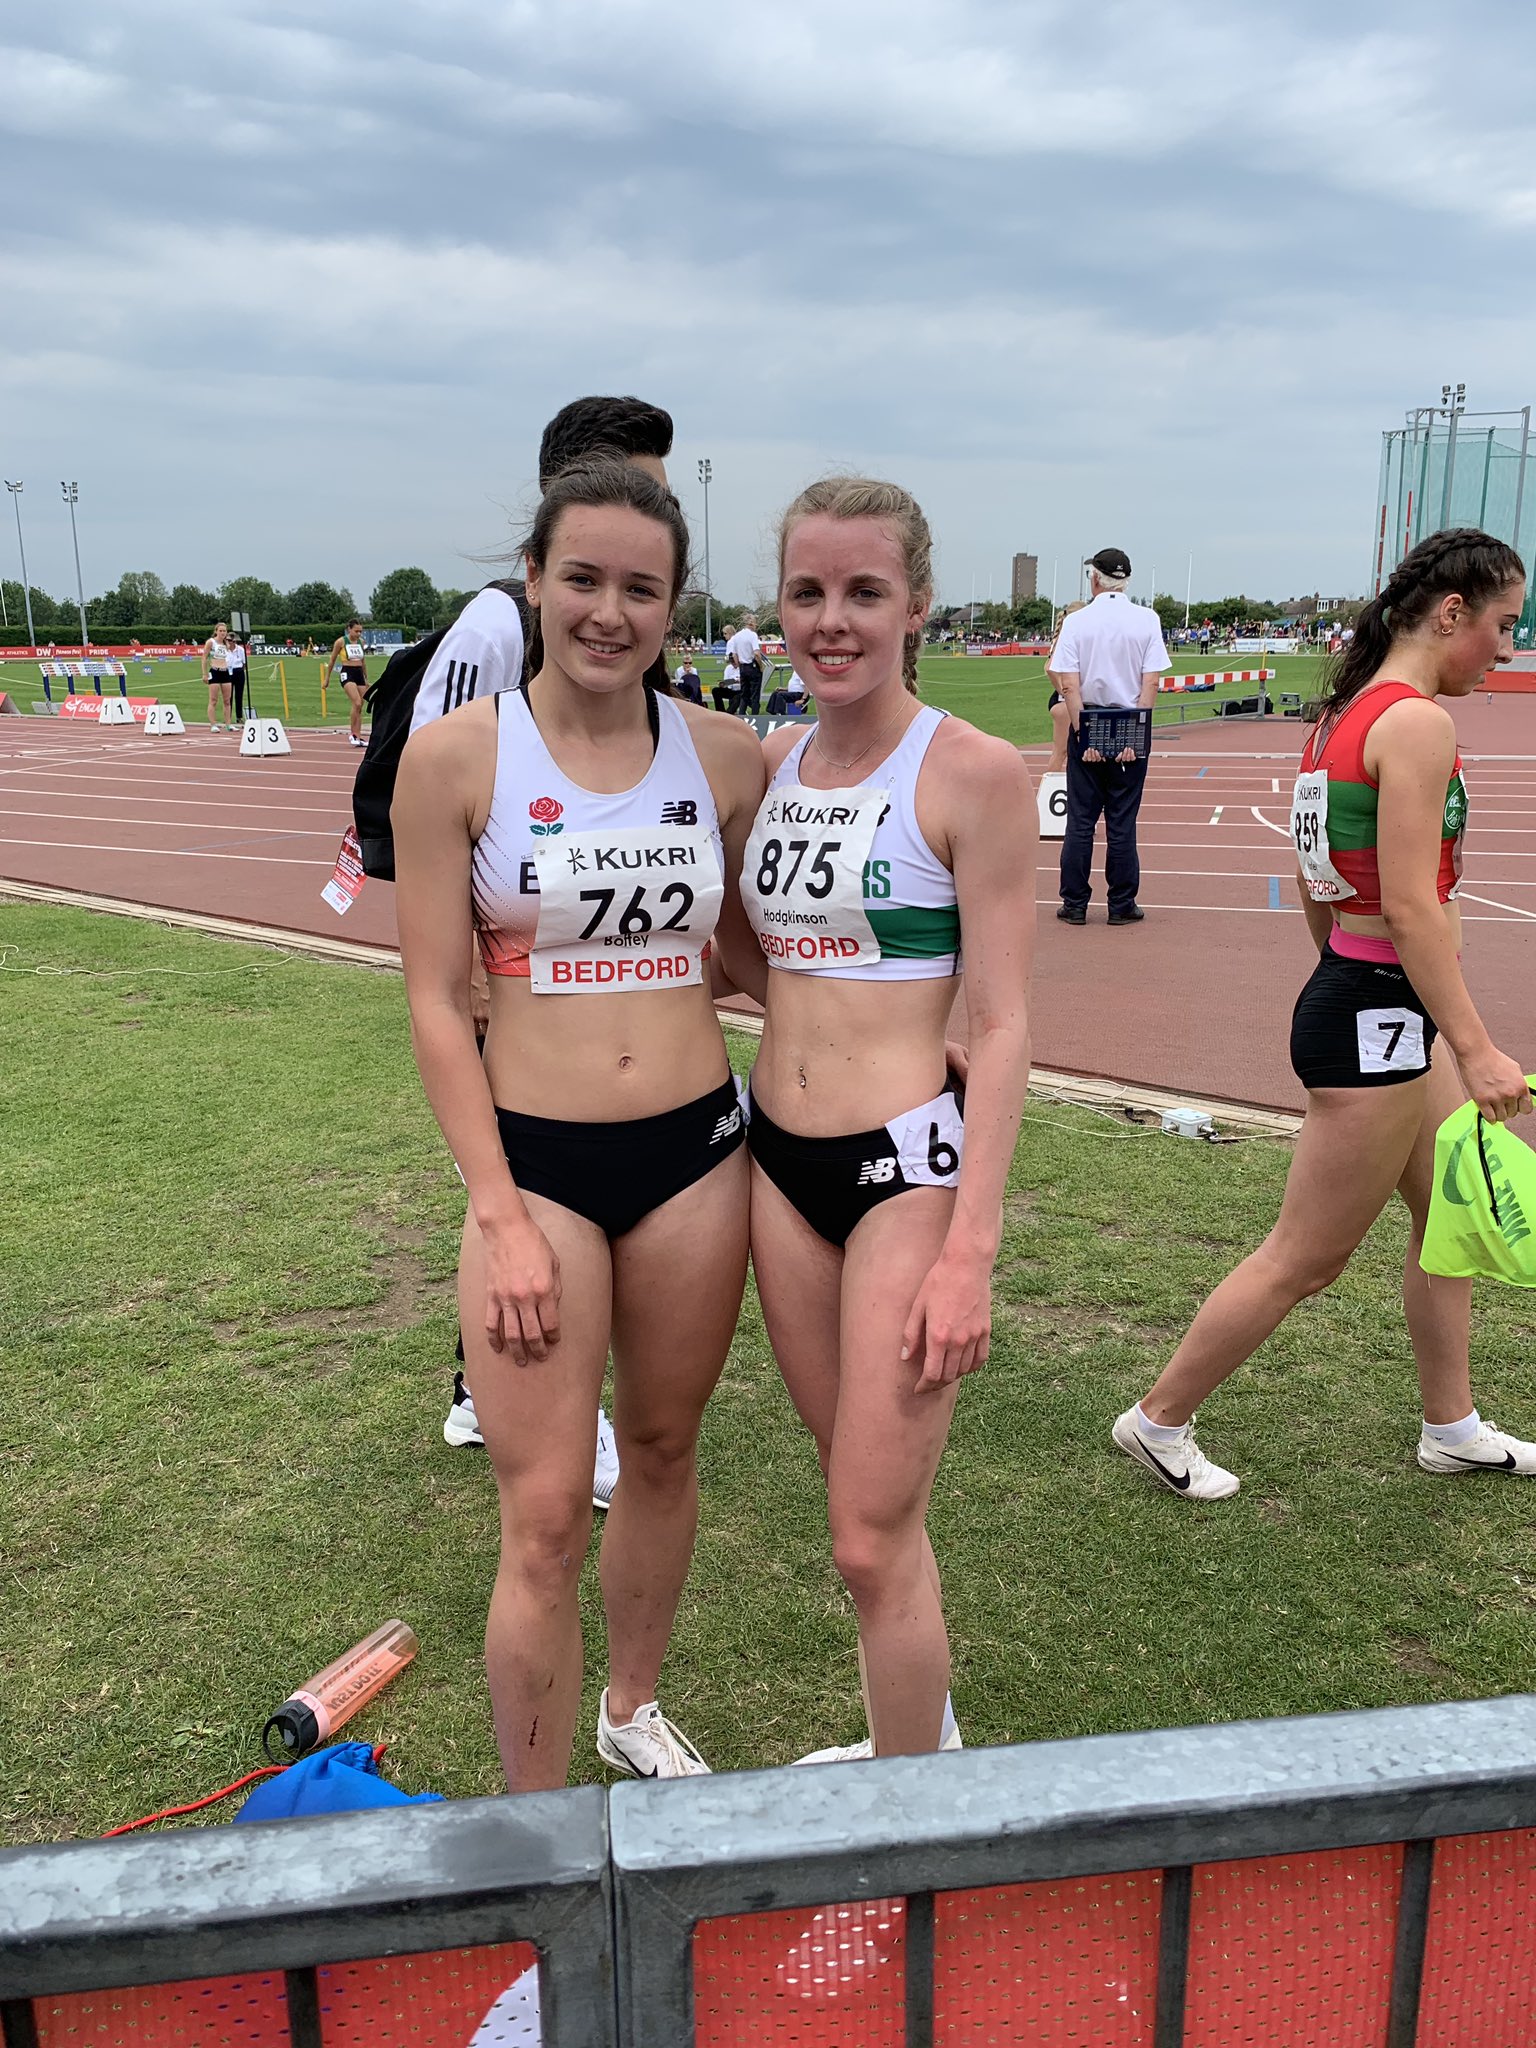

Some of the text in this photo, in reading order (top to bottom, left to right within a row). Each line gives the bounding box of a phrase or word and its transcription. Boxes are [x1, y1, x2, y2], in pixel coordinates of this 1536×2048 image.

[36, 648, 51, 657] DW
[78, 702, 101, 713] ENGLA
[104, 704, 108, 715] 1
[116, 703, 124, 715] 1
[150, 711, 156, 724] 2
[165, 711, 175, 724] 2
[247, 727, 256, 743] 3
[267, 726, 279, 743] 3
[1300, 786, 1321, 801] KUKRI
[1049, 789, 1067, 817] 6
[781, 802, 860, 826] KUKRI
[1295, 811, 1319, 853] 959
[594, 846, 696, 871] KUKRI
[756, 838, 842, 899] 875
[578, 881, 694, 941] 762
[763, 907, 828, 926] Hodgkinson
[604, 933, 649, 948] Boffey
[760, 932, 860, 960] BEDFORD
[552, 955, 690, 984] BEDFORD
[1374, 968, 1403, 980] DRI-FIT
[1377, 1021, 1406, 1062] 7
[927, 1121, 959, 1177] 6
